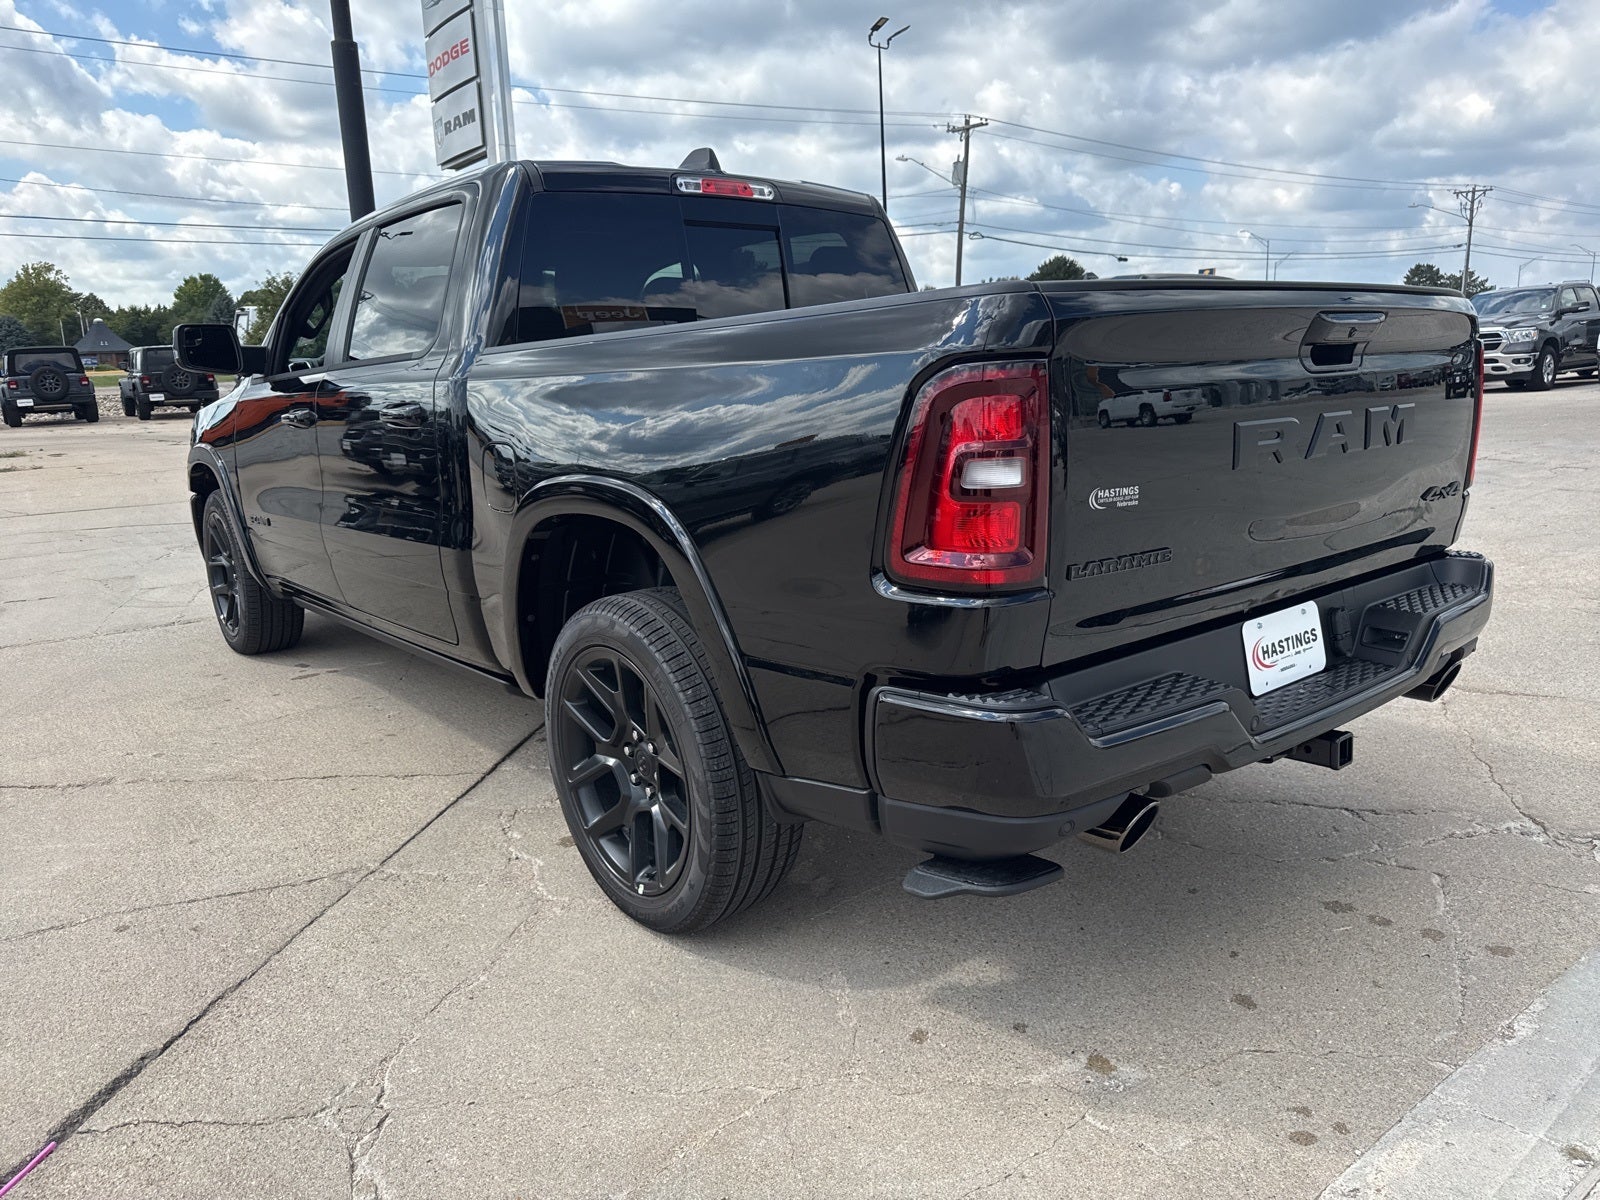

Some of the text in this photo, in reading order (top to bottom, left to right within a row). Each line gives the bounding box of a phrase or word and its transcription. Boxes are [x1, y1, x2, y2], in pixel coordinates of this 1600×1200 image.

[429, 38, 470, 77] DODGE
[444, 108, 476, 136] RAM
[1232, 403, 1415, 470] RAM
[1098, 486, 1139, 498] HASTINGS
[1066, 547, 1173, 581] LARAMIE
[1261, 628, 1318, 660] HASTINGS
